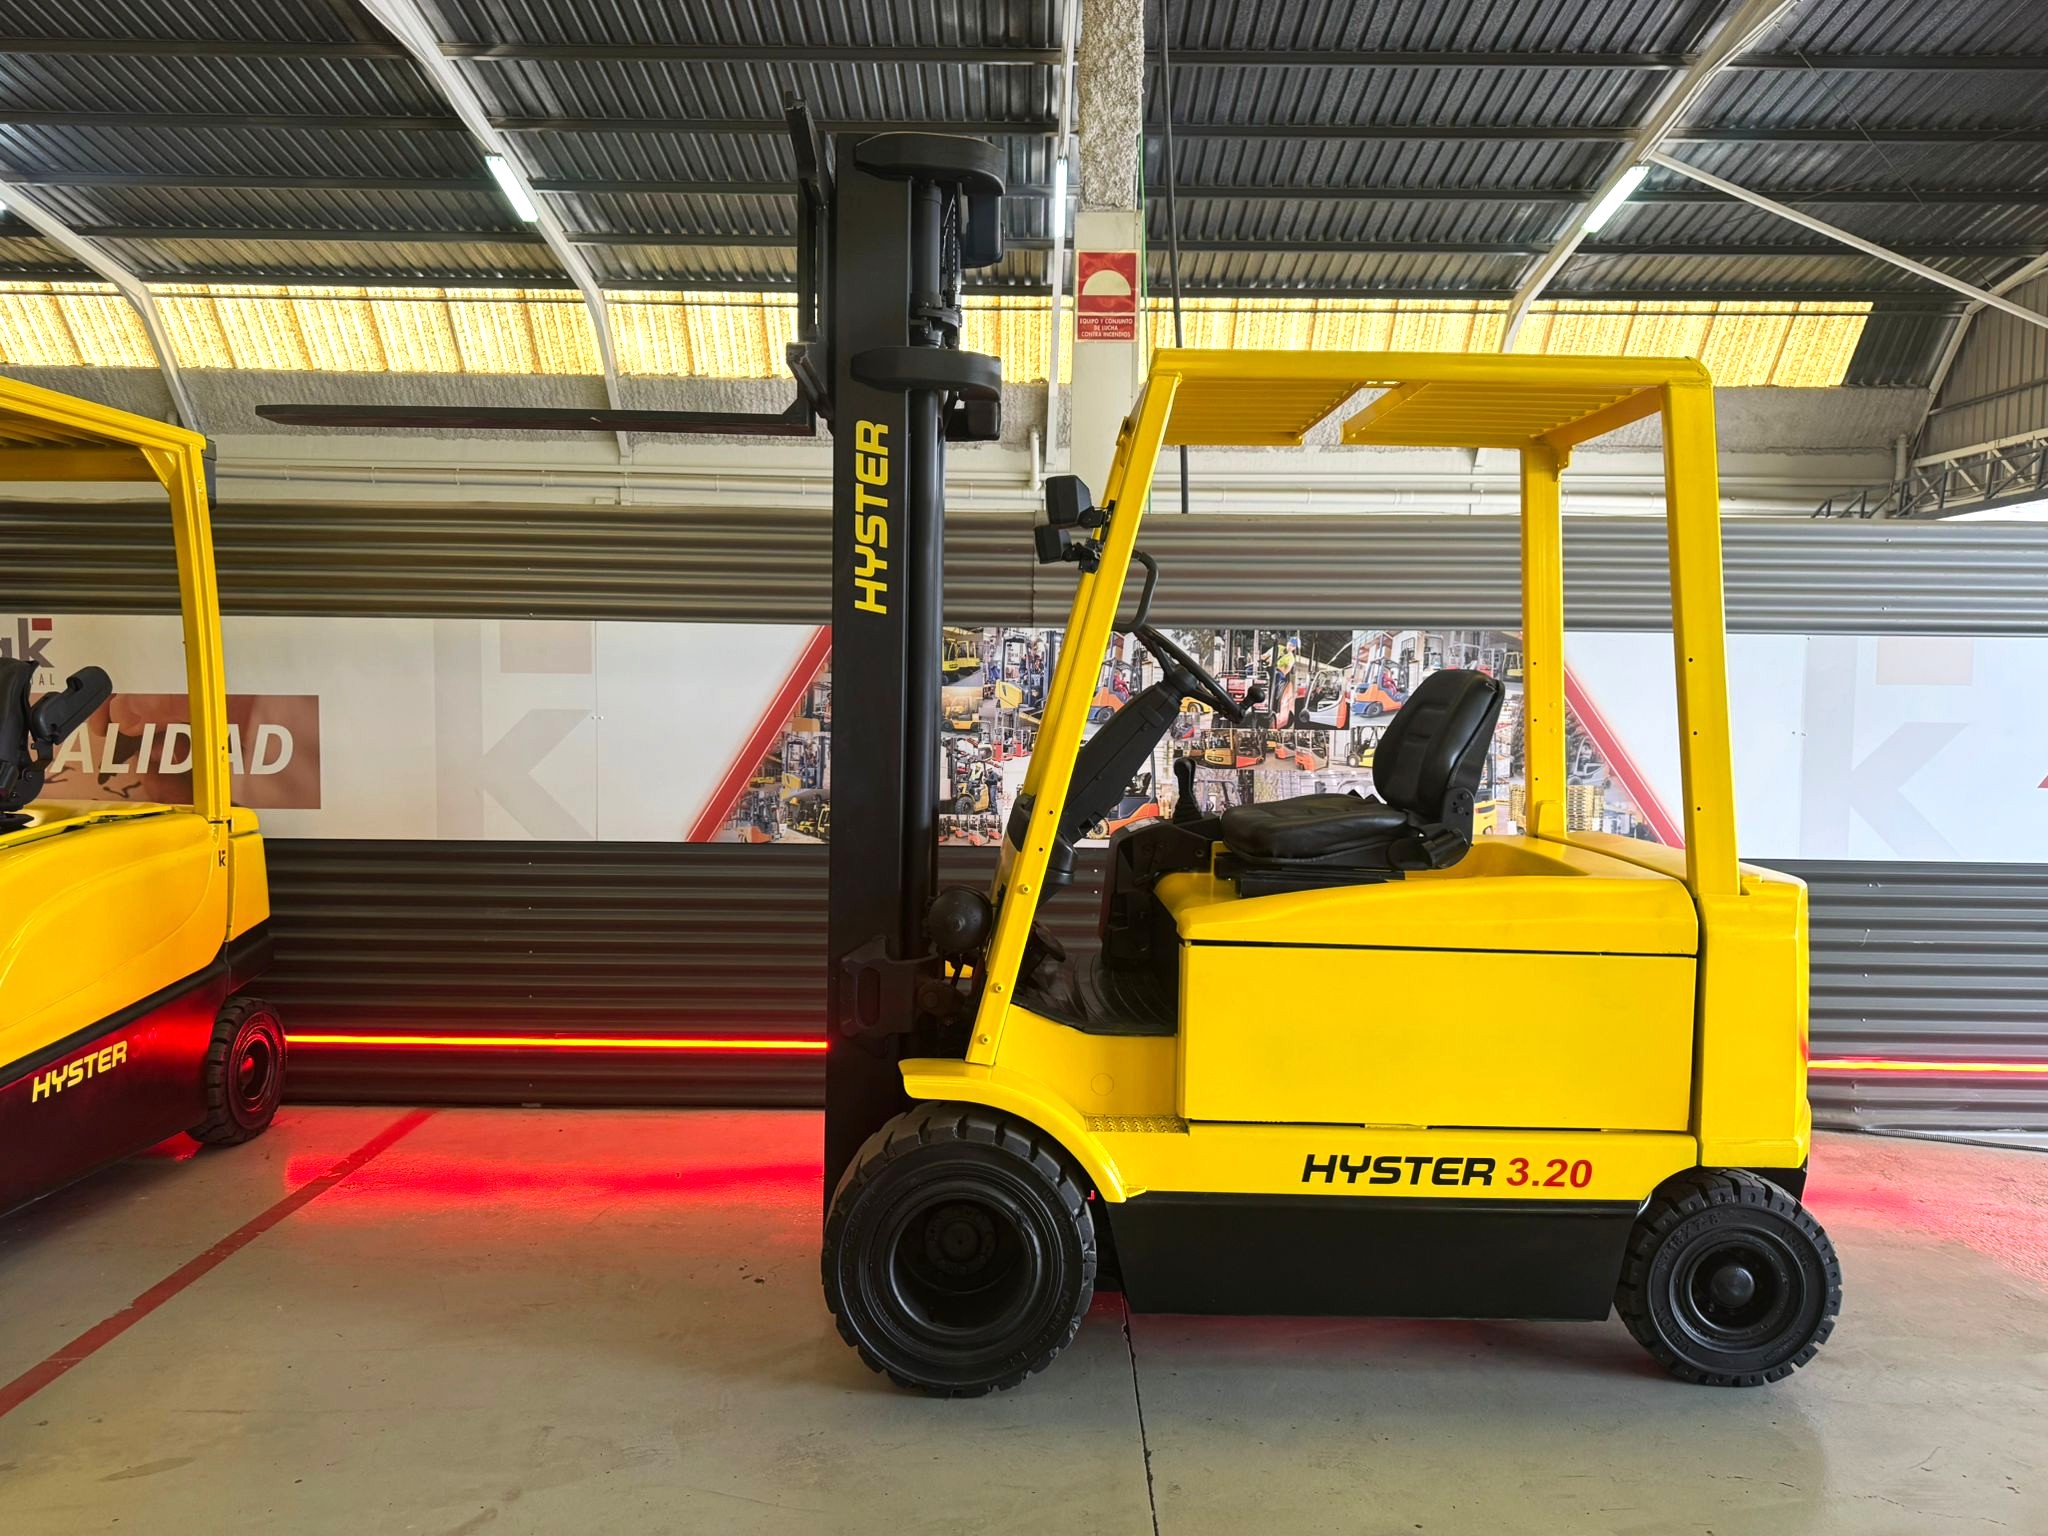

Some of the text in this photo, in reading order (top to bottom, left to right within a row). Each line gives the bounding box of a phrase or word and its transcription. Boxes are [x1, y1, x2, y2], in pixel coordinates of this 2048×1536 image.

[854, 420, 889, 615] HYSTER
[50, 722, 293, 775] ALIDD
[32, 1040, 128, 1103] HYSTER
[1301, 1154, 1593, 1188] HYSTER 3.20
